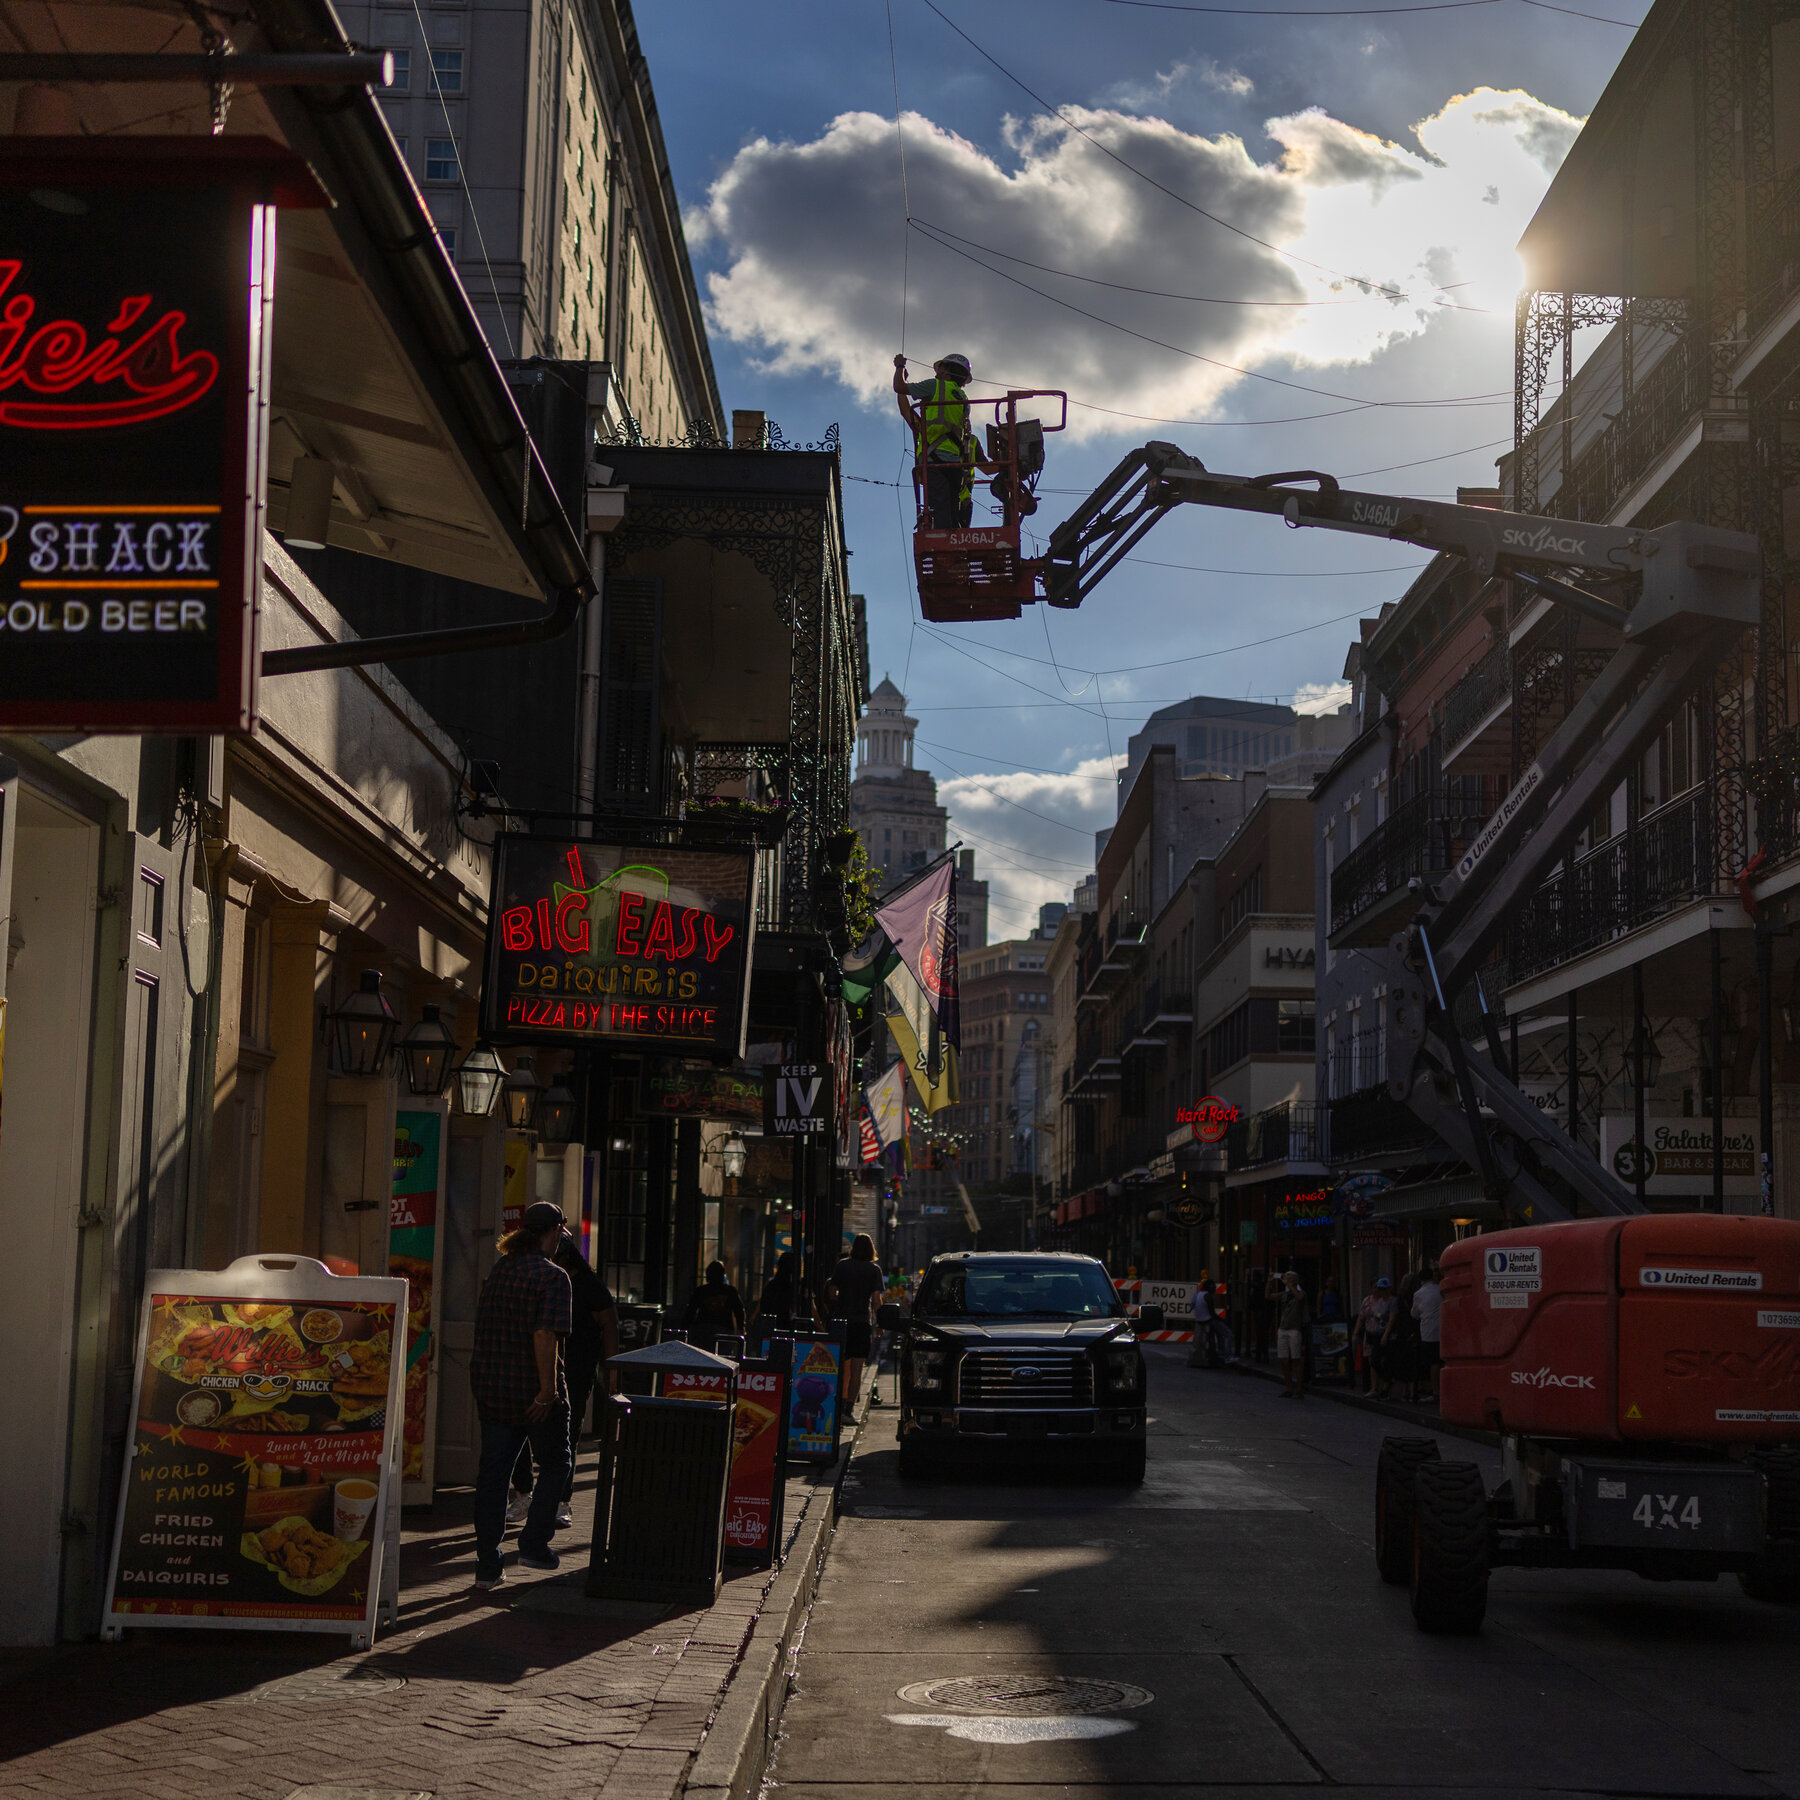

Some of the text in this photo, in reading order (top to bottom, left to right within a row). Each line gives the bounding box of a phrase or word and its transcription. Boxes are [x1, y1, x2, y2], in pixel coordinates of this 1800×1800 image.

[1352, 501, 1400, 527] SJ46AJ
[950, 532, 994, 544] SJ46AJ
[1502, 526, 1586, 556] SKYJACK
[29, 521, 211, 573] SHACK
[102, 601, 207, 633] BEER
[1473, 772, 1538, 860] United Rentals
[503, 891, 734, 963] BIG EASY
[508, 997, 718, 1036] PIZZA BY THE SLICE
[781, 1066, 817, 1077] KEEP
[776, 1077, 823, 1117] IV
[1176, 1105, 1239, 1125] Hard Rock
[774, 1118, 825, 1132] WASTE
[1664, 1158, 1750, 1169] BAR & SEAK
[1509, 1253, 1535, 1262] United
[1509, 1263, 1538, 1273] Rentals
[1487, 1280, 1539, 1289] 1-800-UR-RENTS
[1665, 1272, 1758, 1287] United Rentals
[1152, 1286, 1186, 1299] ROAD
[1145, 1301, 1192, 1314] OSED
[211, 1325, 329, 1363] Willie's
[201, 1376, 330, 1392] CHICKEN SHACK
[1510, 1367, 1596, 1389] SKYJACK
[314, 1437, 365, 1451] Dinner
[275, 1453, 296, 1461] and
[140, 1463, 210, 1481] WORLD
[155, 1482, 237, 1503] FAMOUS
[155, 1514, 214, 1527] FRIED
[727, 1520, 767, 1534] BIG EASY
[139, 1533, 223, 1547] CHICKEN
[166, 1555, 192, 1565] and
[122, 1570, 231, 1586] DAIQUIRIS
